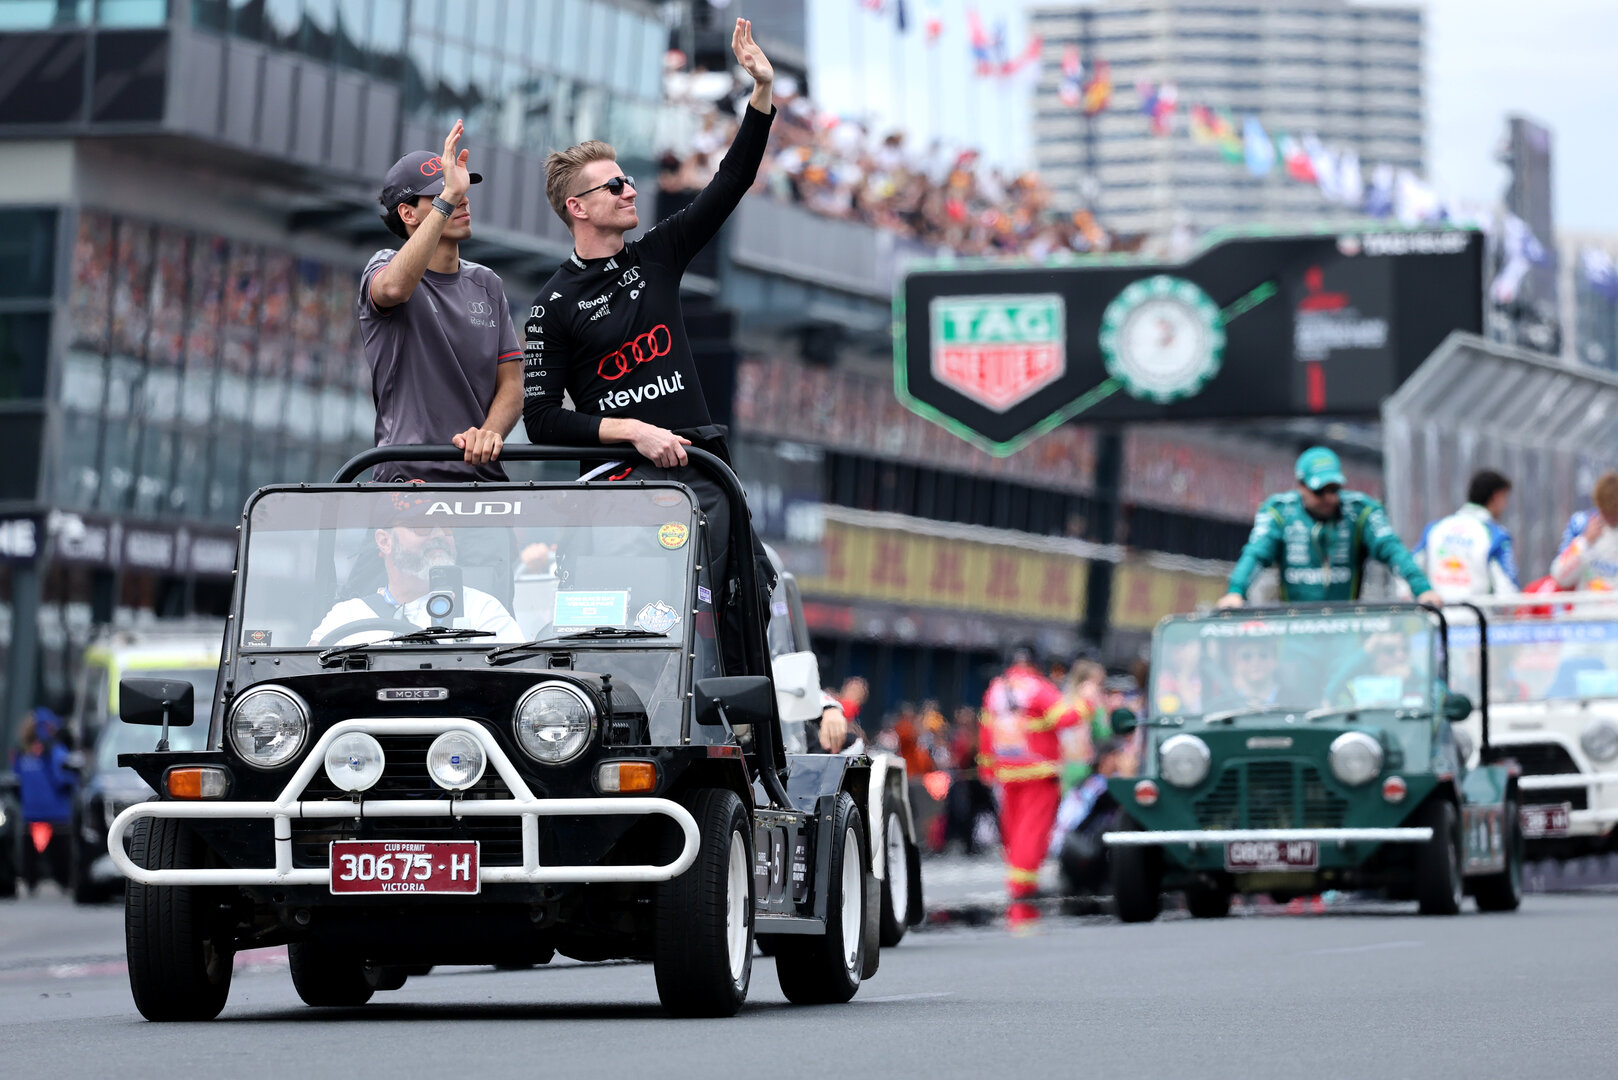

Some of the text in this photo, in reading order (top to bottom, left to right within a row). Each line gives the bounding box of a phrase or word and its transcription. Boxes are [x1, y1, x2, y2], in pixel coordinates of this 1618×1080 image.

[943, 306, 1050, 341] TAG
[598, 371, 685, 411] Revolut
[425, 501, 521, 515] AUDI
[395, 690, 430, 698] MOKE
[384, 843, 426, 852] CLUB PERMIT
[381, 883, 426, 891] VICTORIA
